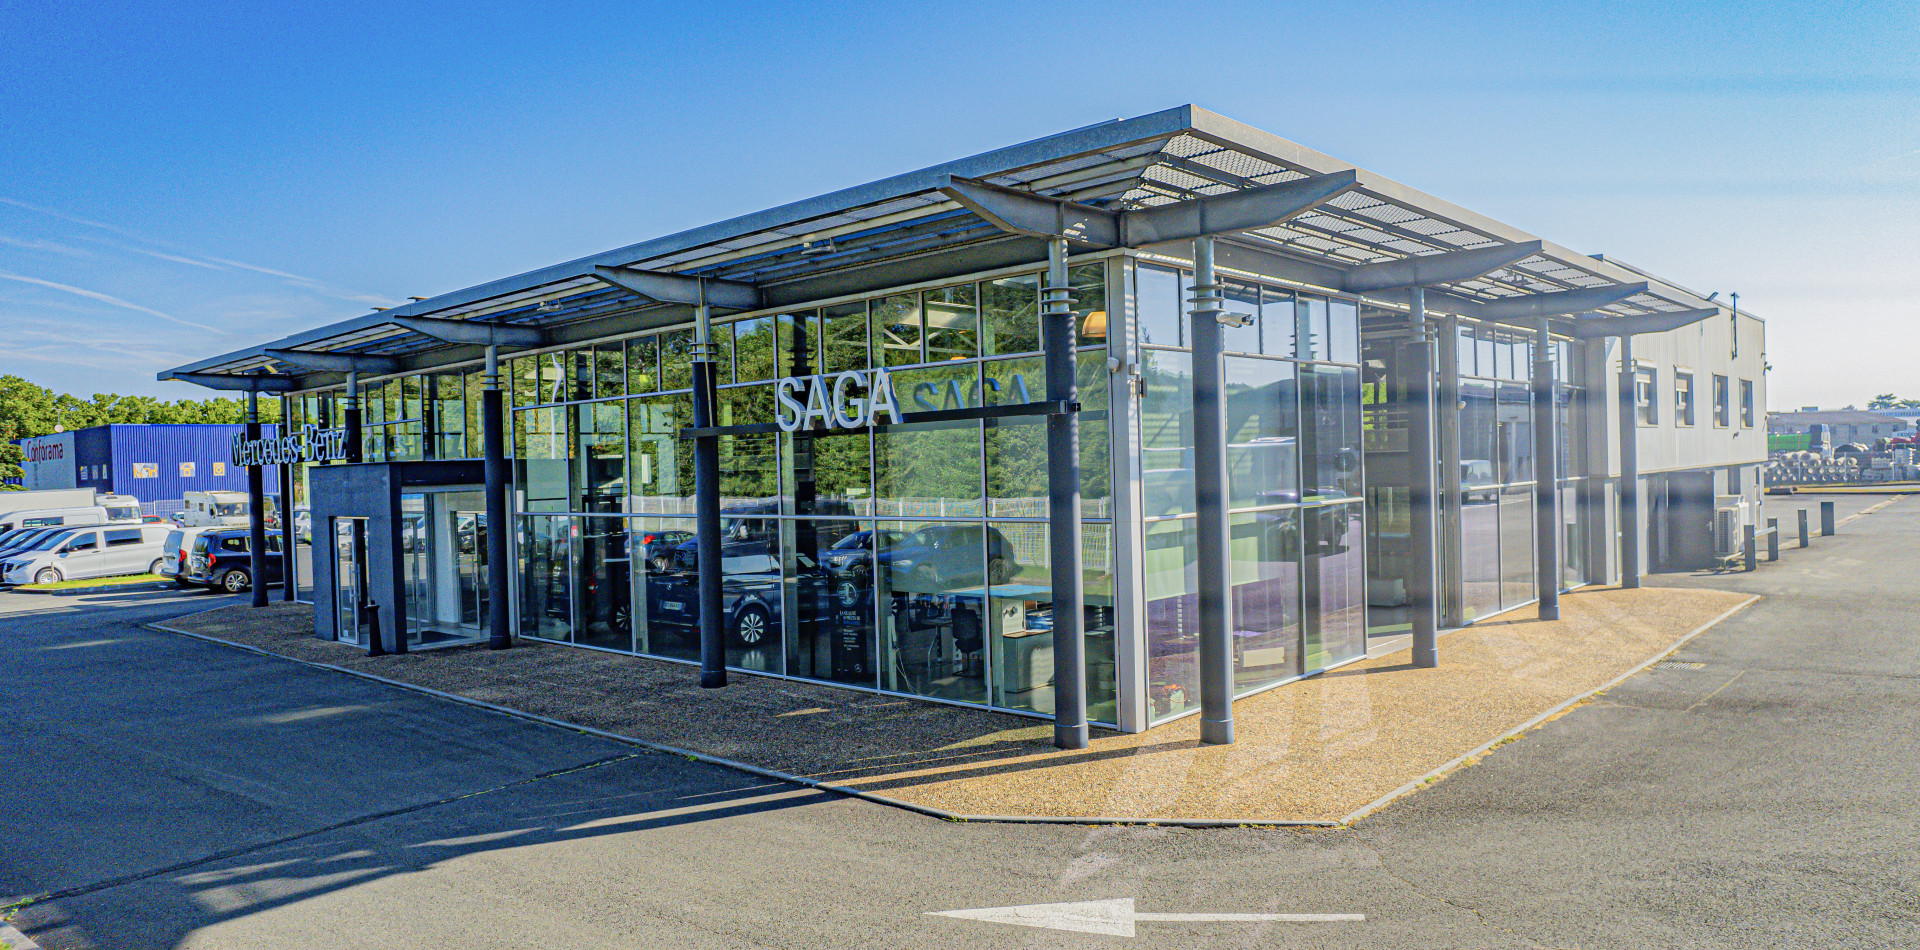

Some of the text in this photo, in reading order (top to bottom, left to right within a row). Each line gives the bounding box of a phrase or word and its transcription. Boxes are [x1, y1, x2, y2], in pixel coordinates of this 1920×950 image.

[777, 367, 903, 432] SAGA
[27, 439, 63, 464] Conforama
[231, 424, 346, 466] Mercedes-Benz
